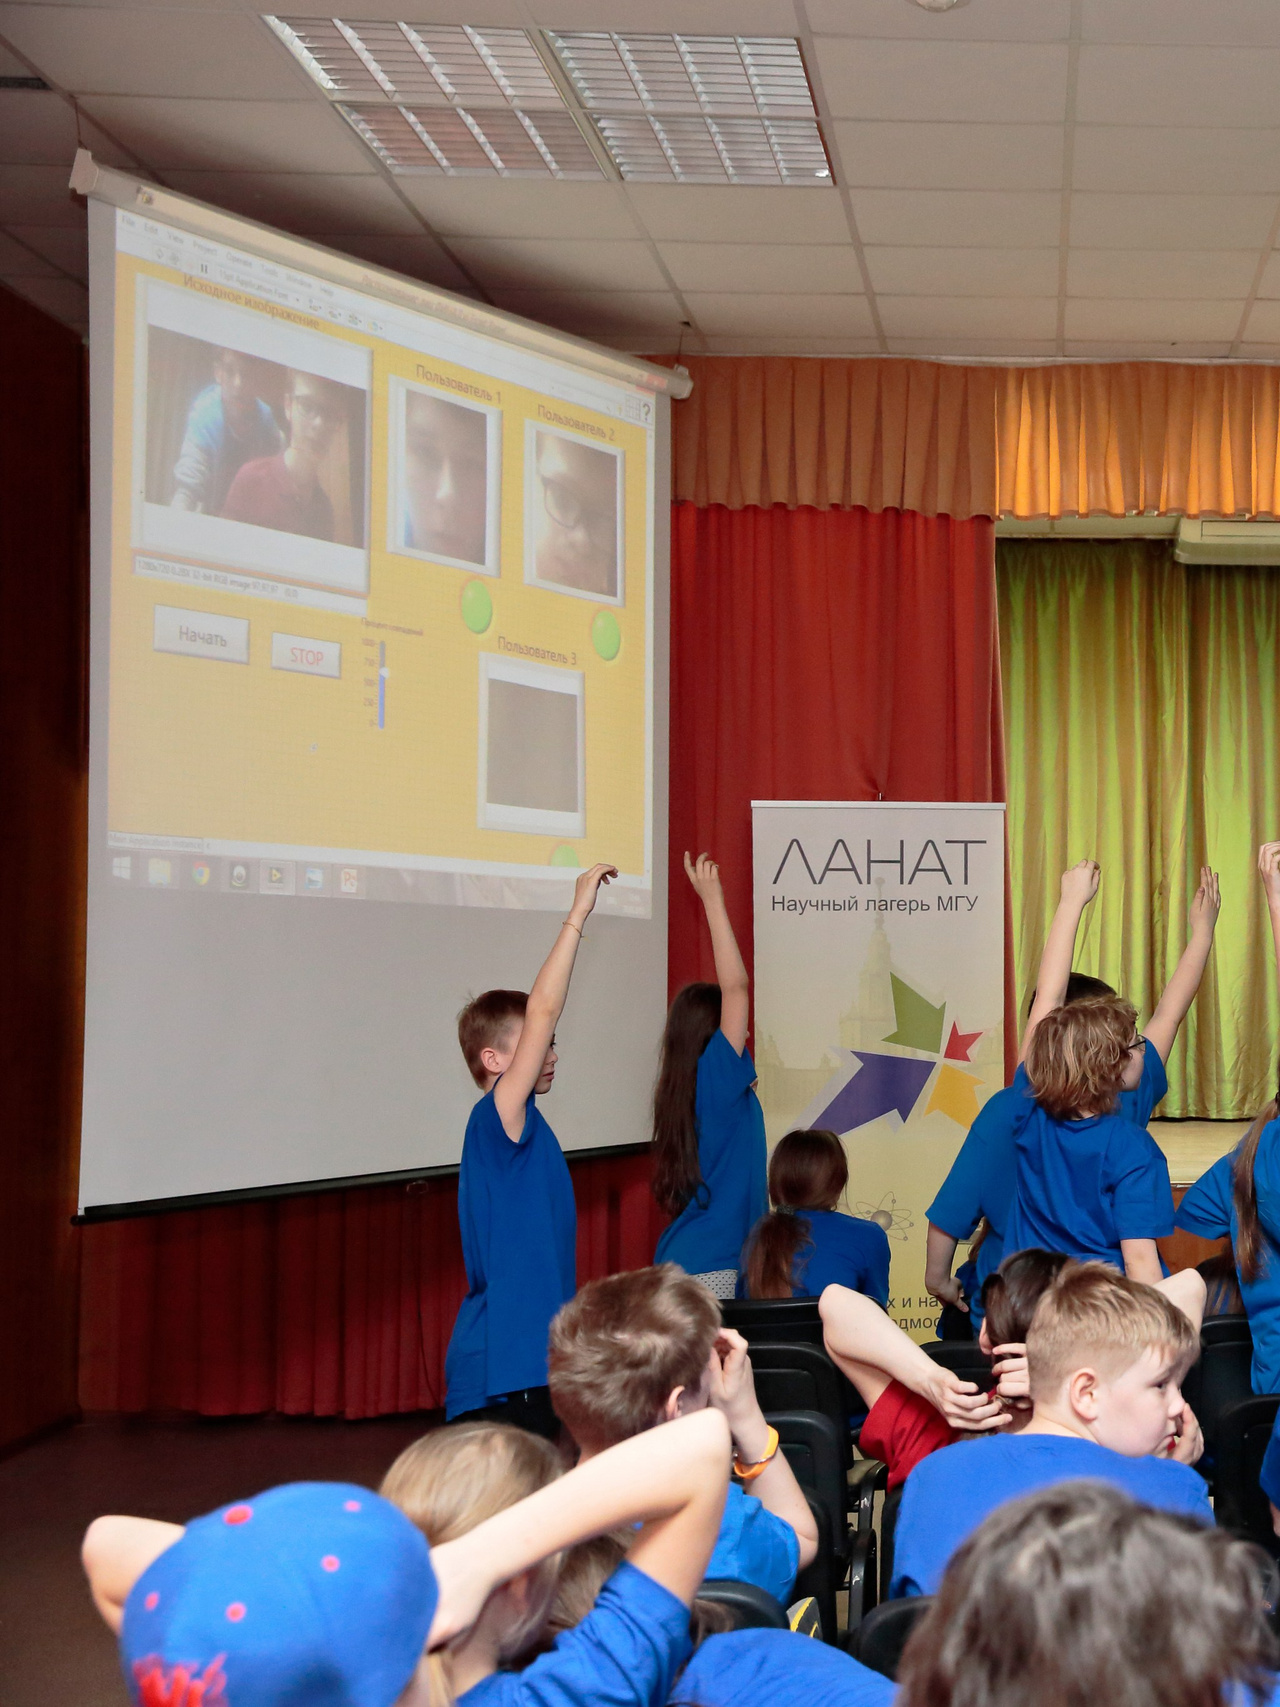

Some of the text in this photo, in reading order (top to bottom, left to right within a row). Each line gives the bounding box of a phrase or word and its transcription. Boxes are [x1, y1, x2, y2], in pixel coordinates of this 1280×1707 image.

[184, 273, 243, 304] Исходное
[416, 364, 492, 402] Пользователь
[537, 404, 615, 441] Пользователь 2
[179, 625, 228, 648] Начать
[290, 647, 324, 666] STOP
[497, 635, 577, 666] Пользователь 3
[772, 838, 987, 886] ЛАНАТ
[772, 896, 979, 915] Научный лагерь МГУ
[902, 1298, 912, 1308] и
[918, 1297, 944, 1311] на
[891, 1317, 941, 1332] дмос
